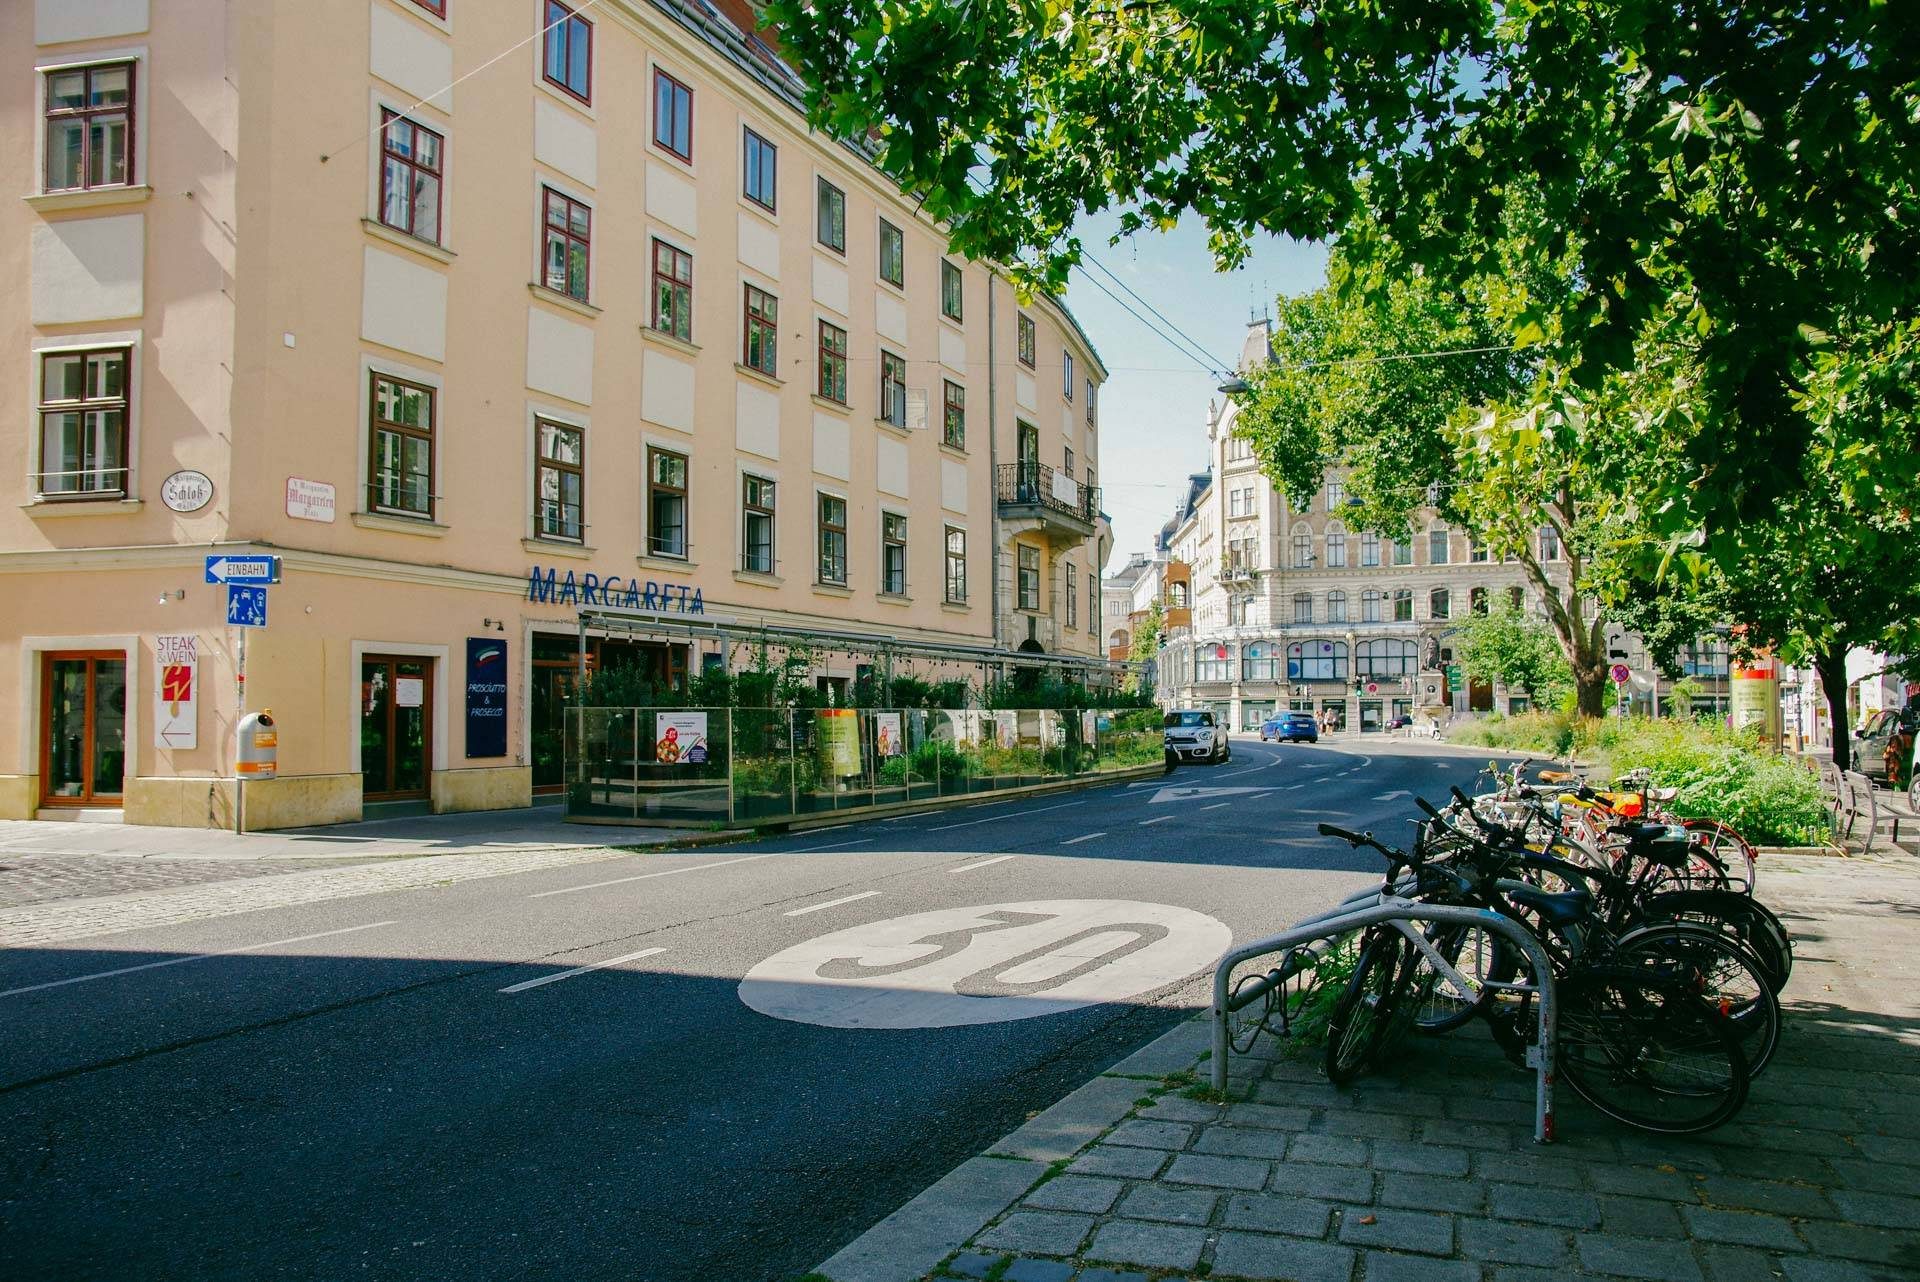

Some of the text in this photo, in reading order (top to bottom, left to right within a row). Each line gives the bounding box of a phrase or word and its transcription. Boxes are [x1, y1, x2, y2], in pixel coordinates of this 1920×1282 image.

[288, 488, 334, 509] Margareten
[227, 563, 266, 576] EINBAHN
[157, 636, 195, 651] STEAK
[468, 683, 506, 693] PROSCIUTTO
[470, 708, 503, 717] PROSECCO
[815, 910, 1170, 998] 30
